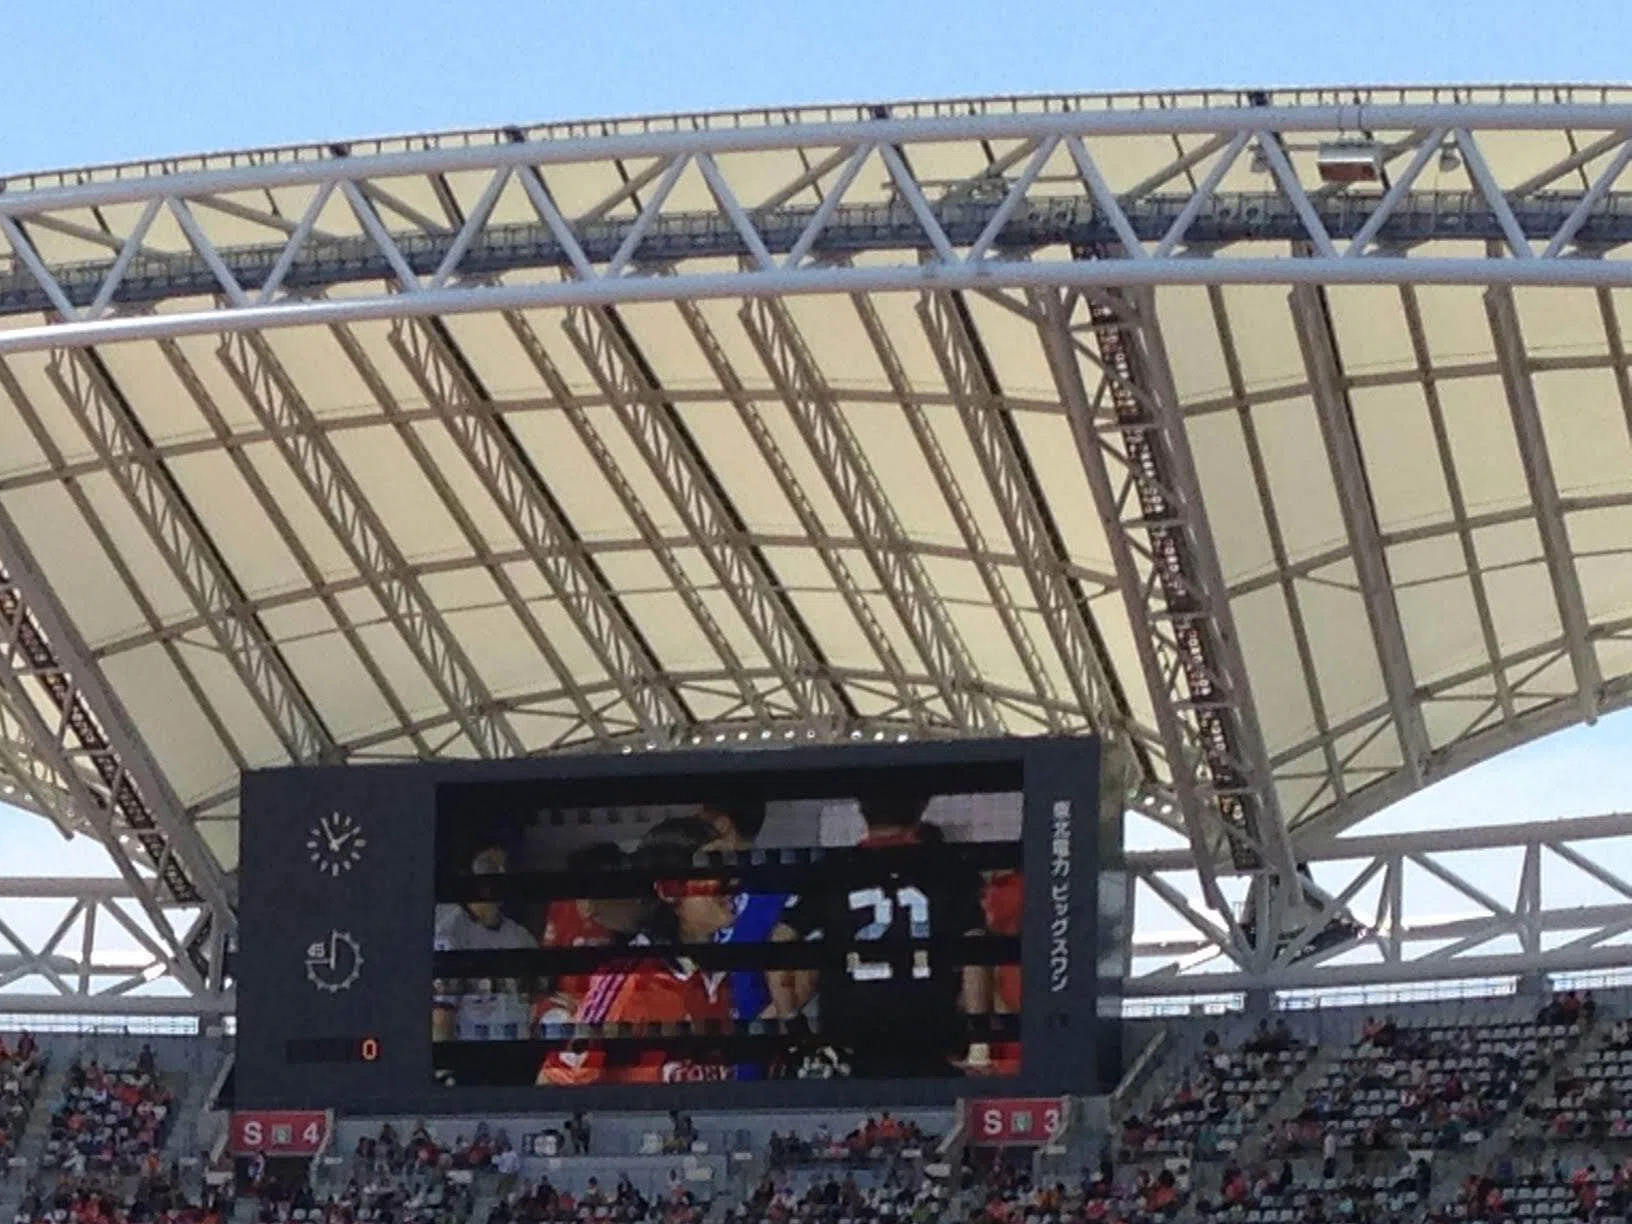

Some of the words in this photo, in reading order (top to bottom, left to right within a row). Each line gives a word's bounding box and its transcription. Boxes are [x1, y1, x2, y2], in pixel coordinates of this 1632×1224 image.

[847, 886, 930, 980] 21
[362, 1039, 377, 1060] 0
[243, 1120, 264, 1146] S
[302, 1121, 319, 1144] 4
[983, 1108, 1003, 1135] S
[1044, 1109, 1060, 1133] 3
